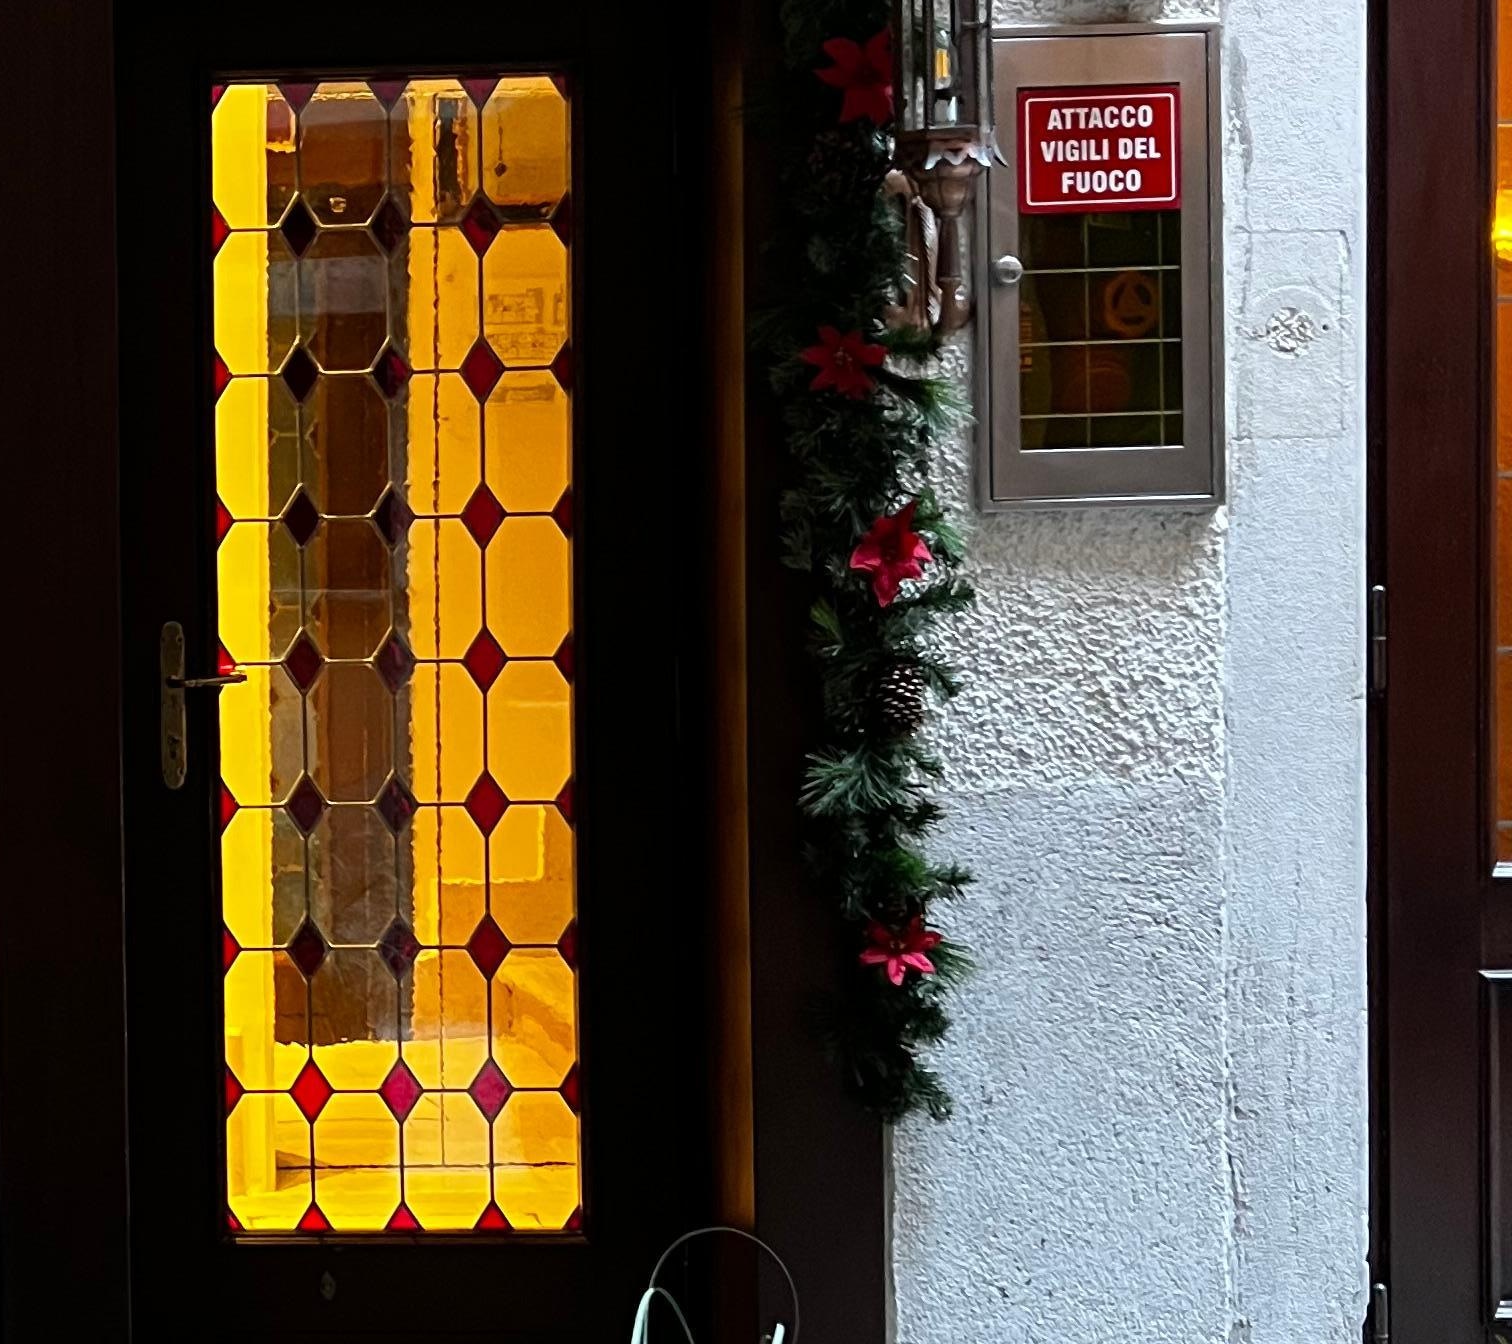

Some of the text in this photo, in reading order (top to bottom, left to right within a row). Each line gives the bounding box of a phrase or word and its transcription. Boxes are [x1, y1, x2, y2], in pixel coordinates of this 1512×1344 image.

[1047, 105, 1154, 131] ATTACCO
[1040, 137, 1161, 163] VIGILI DEL
[1061, 169, 1142, 194] FUOCO
